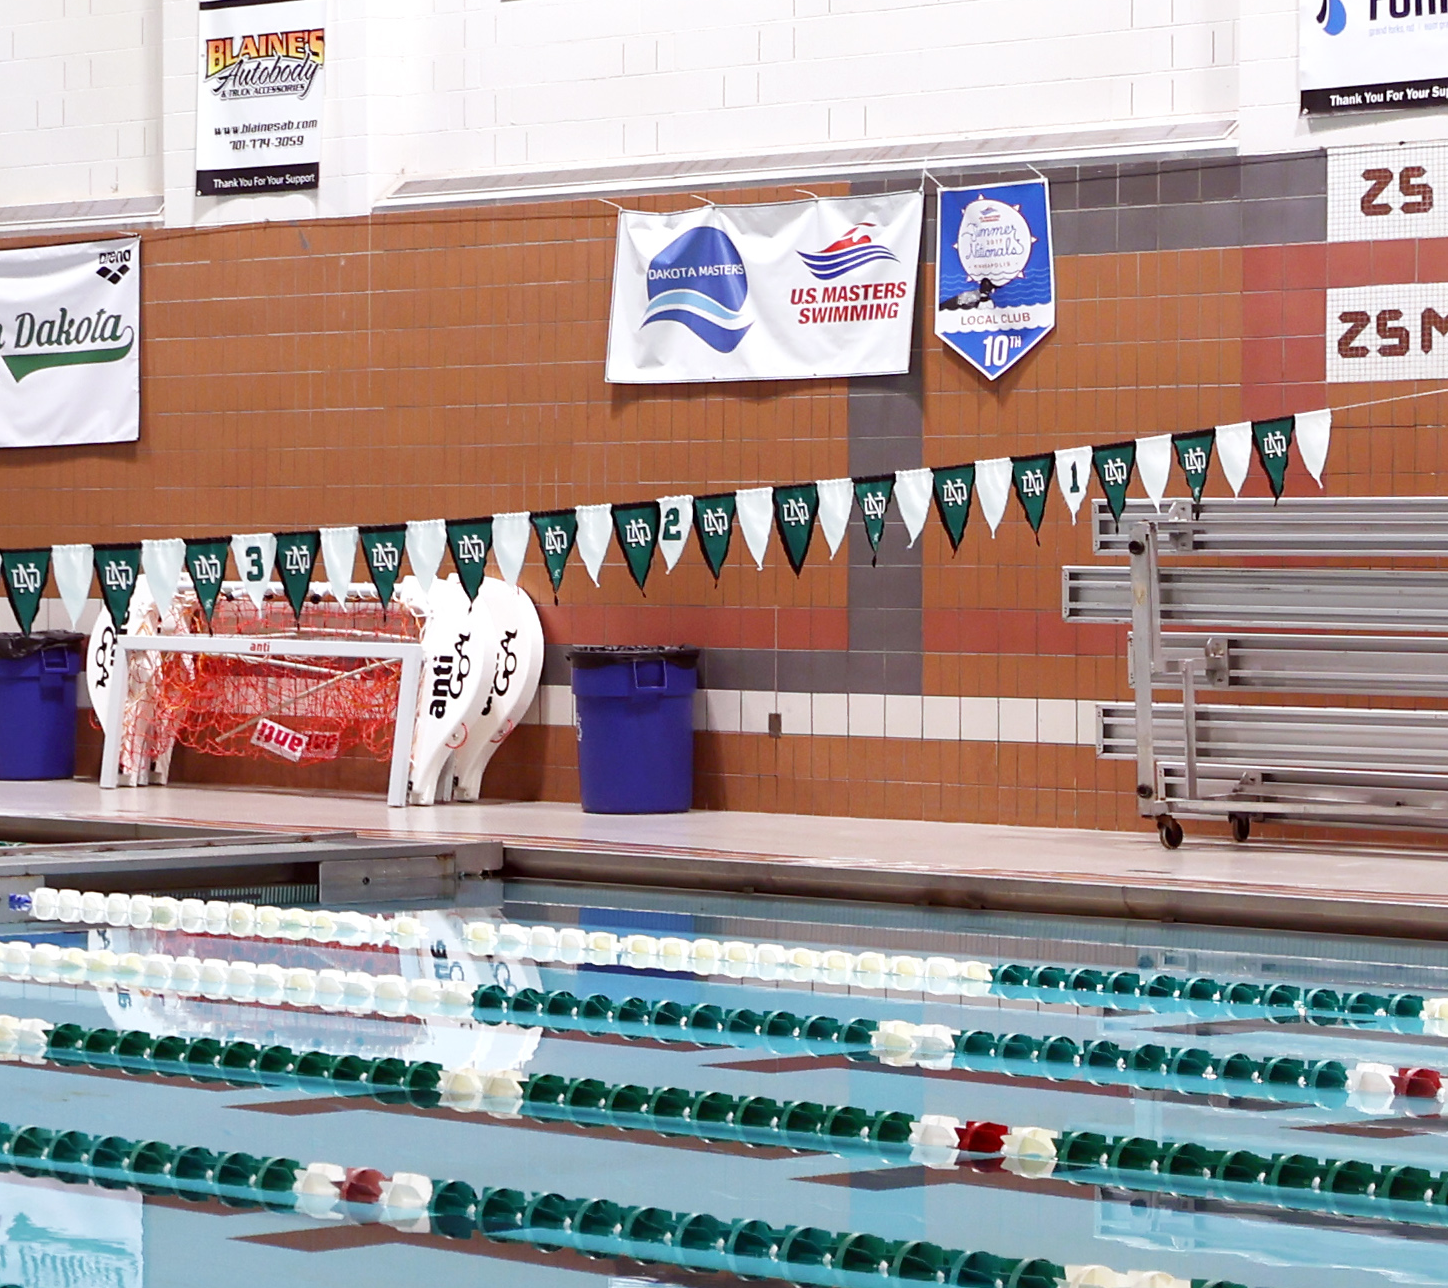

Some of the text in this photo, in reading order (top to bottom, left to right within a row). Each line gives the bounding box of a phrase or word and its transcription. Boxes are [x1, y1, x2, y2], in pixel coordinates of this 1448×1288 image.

[206, 28, 326, 79] BLAINE'S
[214, 54, 321, 98] Autobody
[1330, 88, 1429, 106] Thank You For Your
[213, 173, 315, 189] Thank You For Your Support
[1360, 166, 1434, 216] 25
[99, 250, 131, 264] arena
[648, 263, 744, 280] DAKOTA MASTERS
[790, 281, 906, 305] U.S. MASTERS
[798, 302, 899, 324] SWIMMING
[961, 312, 1030, 325] LOCAL CLUB
[14, 308, 122, 349] Dakota
[983, 335, 1021, 366] 10TH
[246, 547, 264, 582] 3
[250, 642, 270, 652] anti
[429, 656, 453, 719] anti
